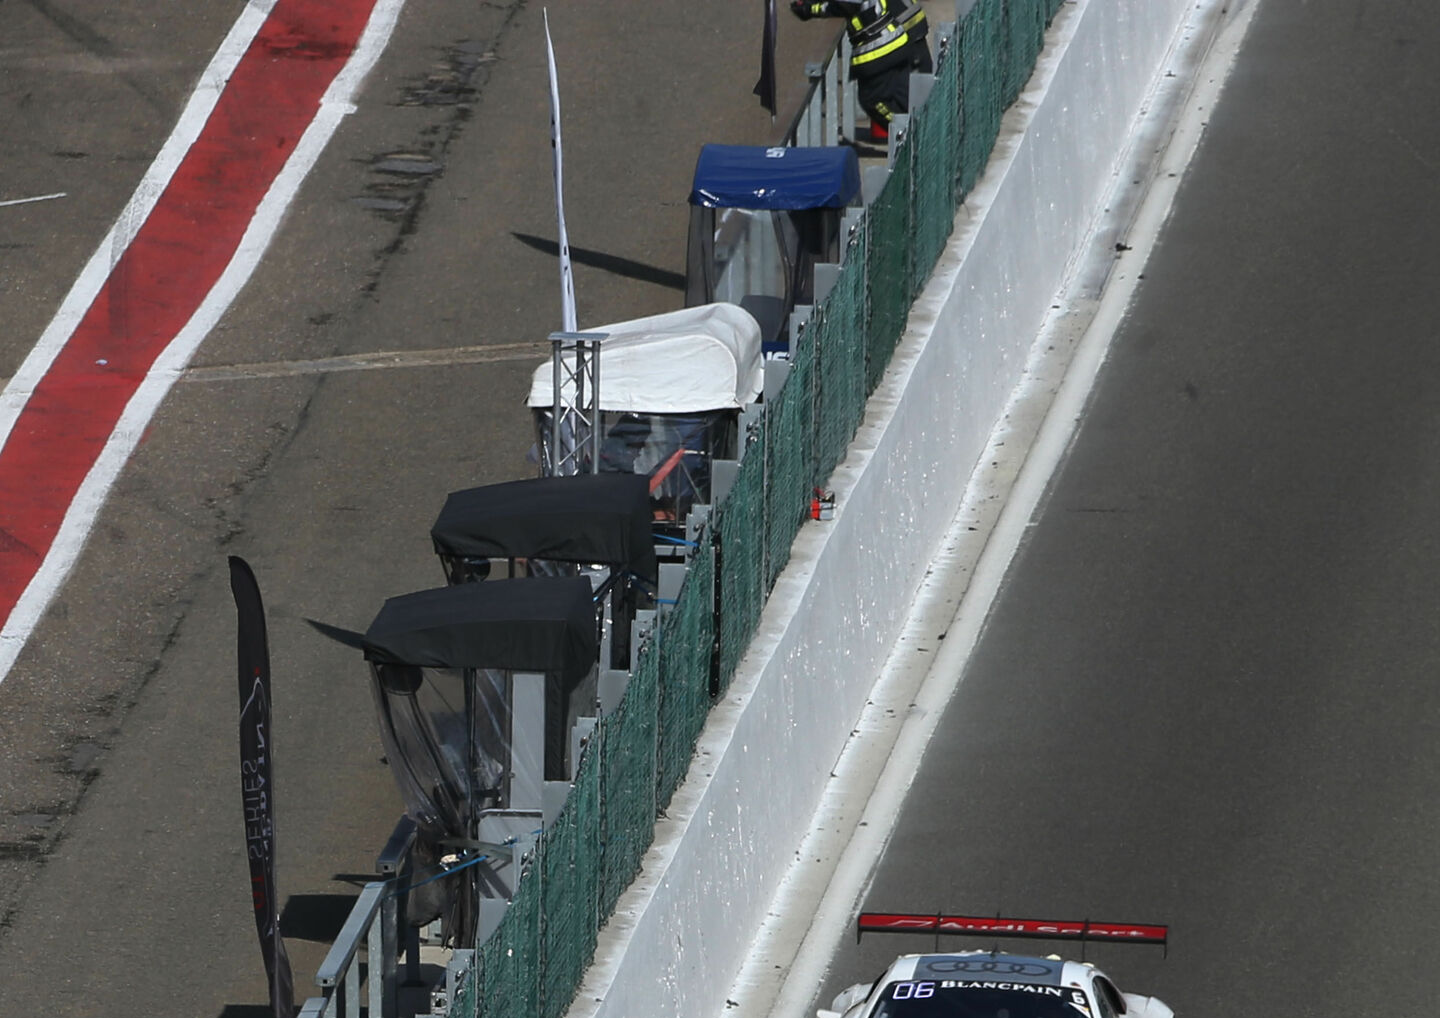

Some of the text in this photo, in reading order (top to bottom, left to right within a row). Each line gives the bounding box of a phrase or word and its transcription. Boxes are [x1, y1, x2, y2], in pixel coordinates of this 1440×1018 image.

[892, 983, 936, 1000] 06
[940, 980, 1063, 997] BLANCPAIN
[1071, 992, 1086, 1005] 6
